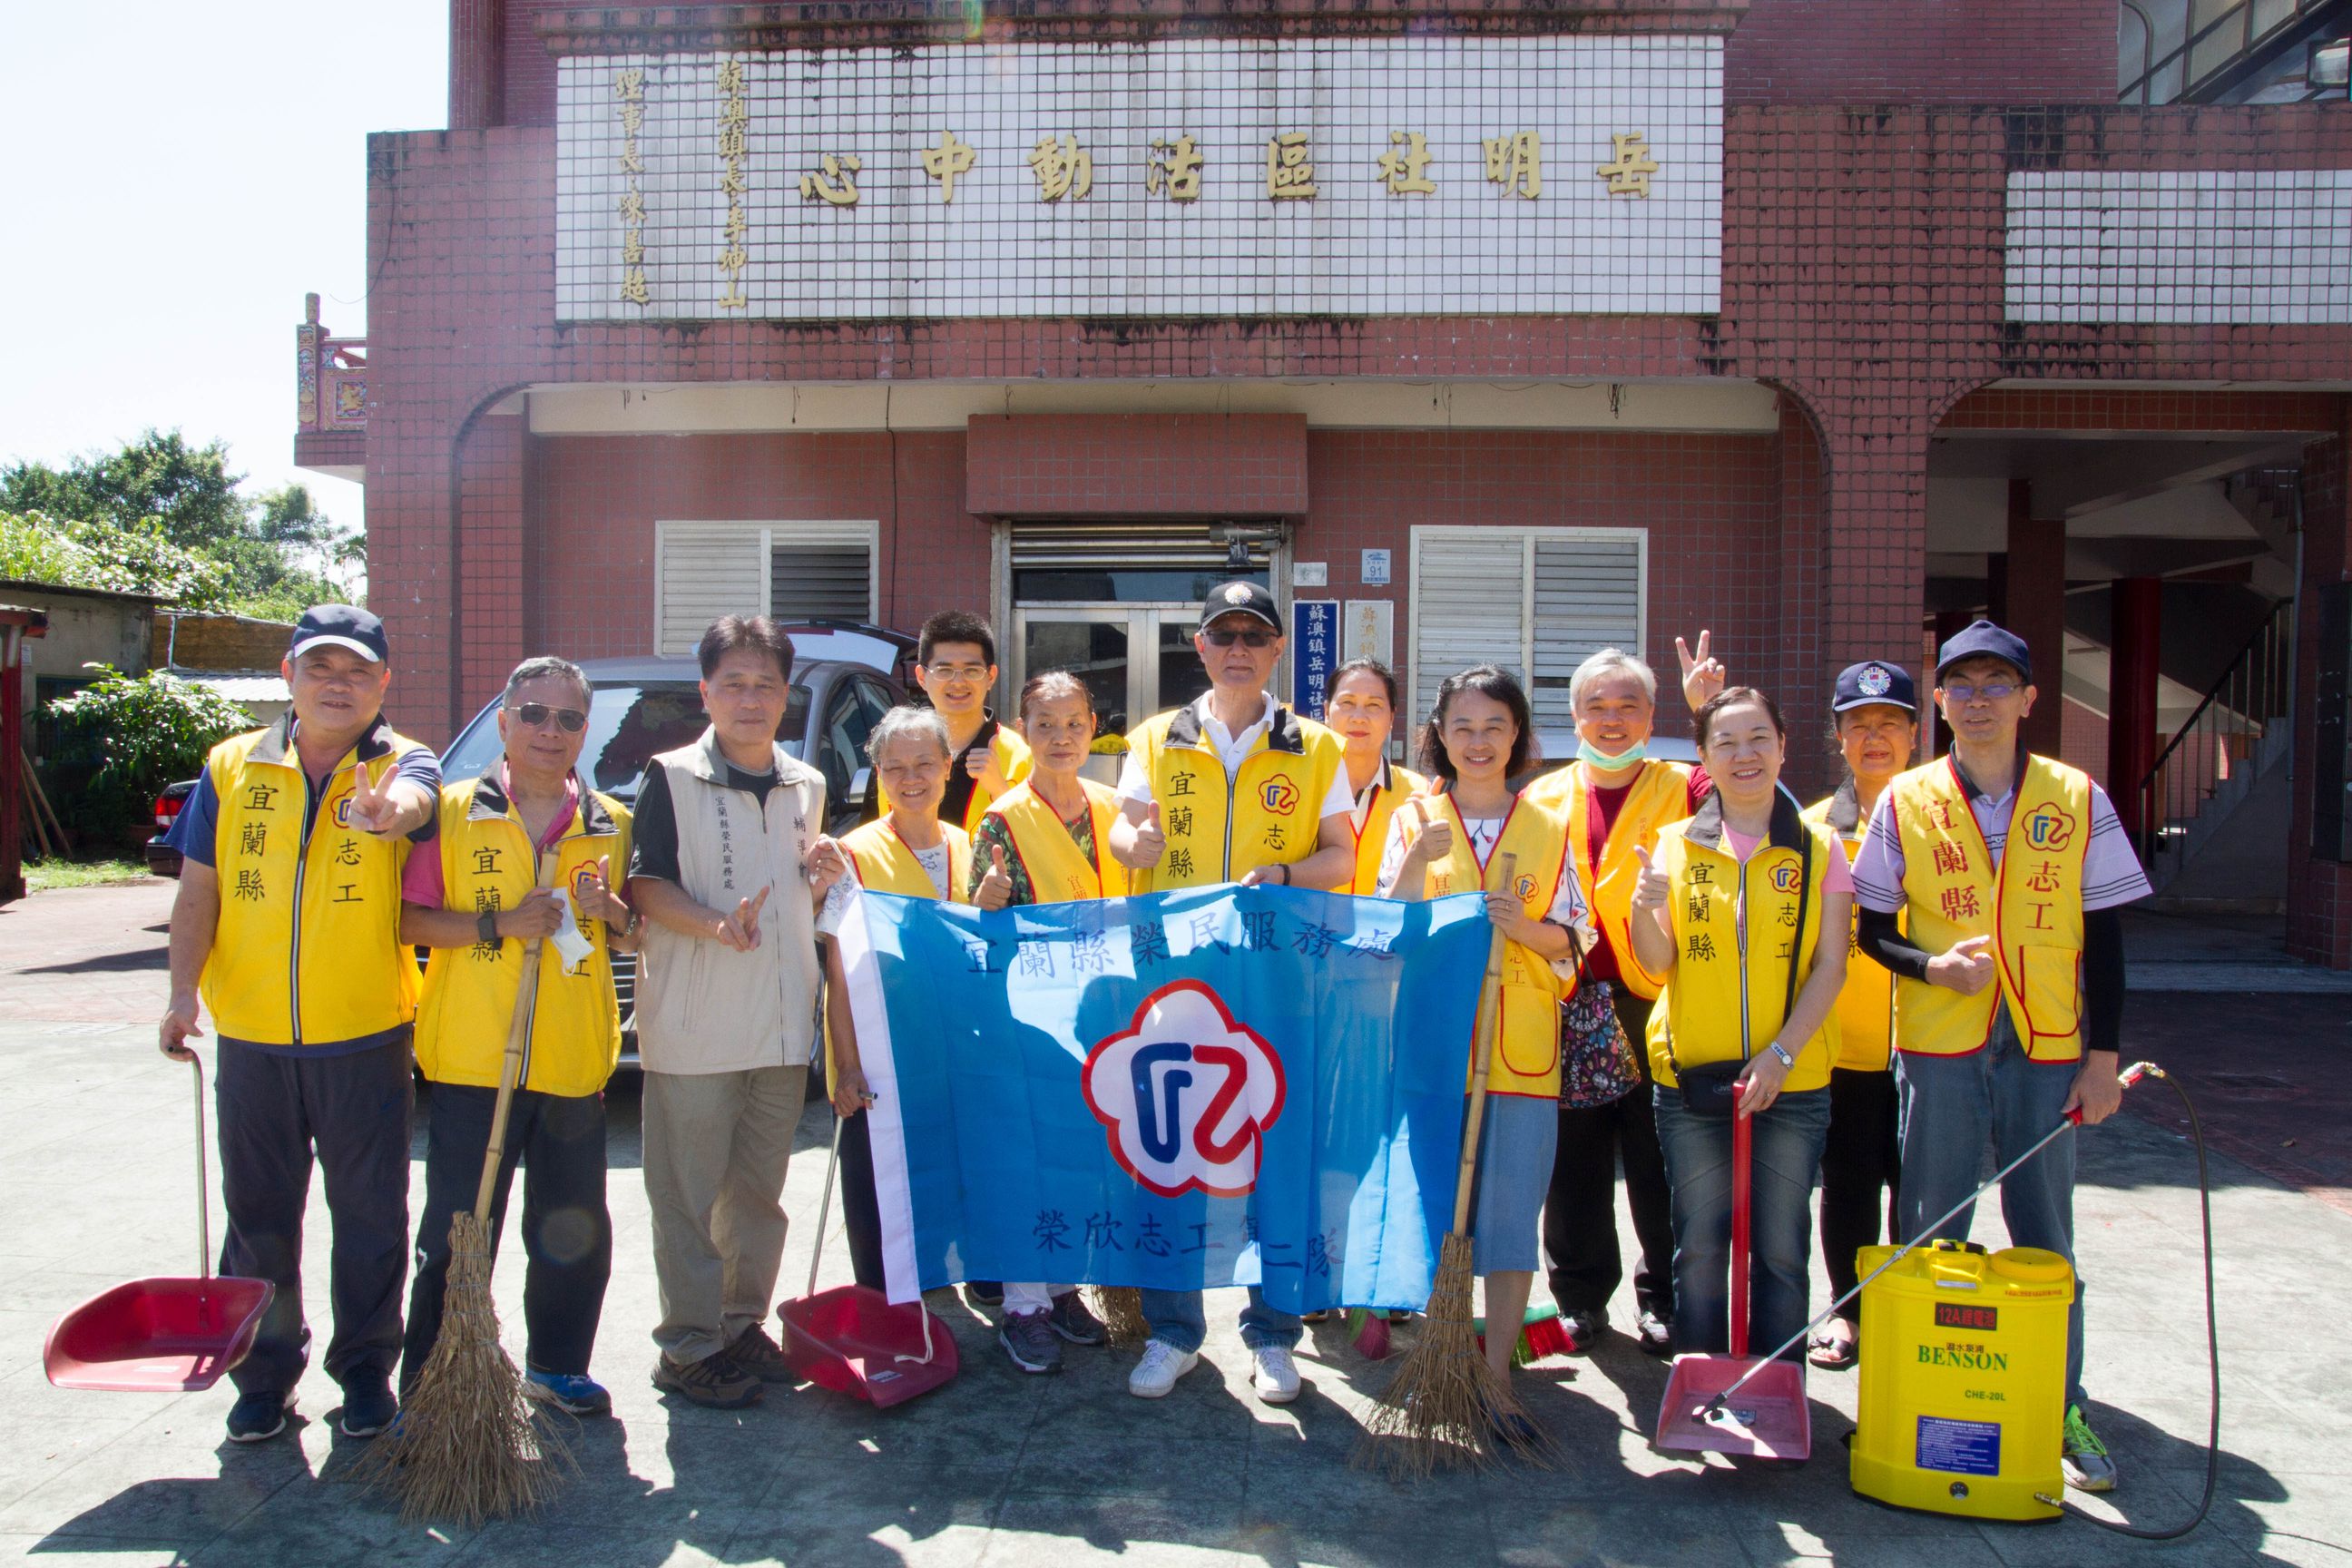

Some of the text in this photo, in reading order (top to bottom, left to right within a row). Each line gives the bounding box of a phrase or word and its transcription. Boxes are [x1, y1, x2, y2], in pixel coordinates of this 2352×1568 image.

[799, 128, 1660, 205] 岳明社區活動中心
[1369, 565, 1382, 577] 91
[233, 784, 280, 903] 宜蘭縣
[714, 795, 736, 891] 宜蘭縣榮民服務處
[792, 816, 808, 879] 輔導會
[1167, 770, 1197, 879] 宜蘭縣
[1922, 798, 1981, 922] 宜蘭縣
[332, 838, 365, 904] 志工
[2025, 859, 2063, 931] 志工
[961, 909, 1396, 979] 宜蘭縣榮民服務處
[1686, 861, 1716, 963] 宜蘭縣
[1775, 901, 1798, 960] 志工
[1916, 1344, 2008, 1372] BENSON
[1964, 1389, 2007, 1403] CHE-20L
